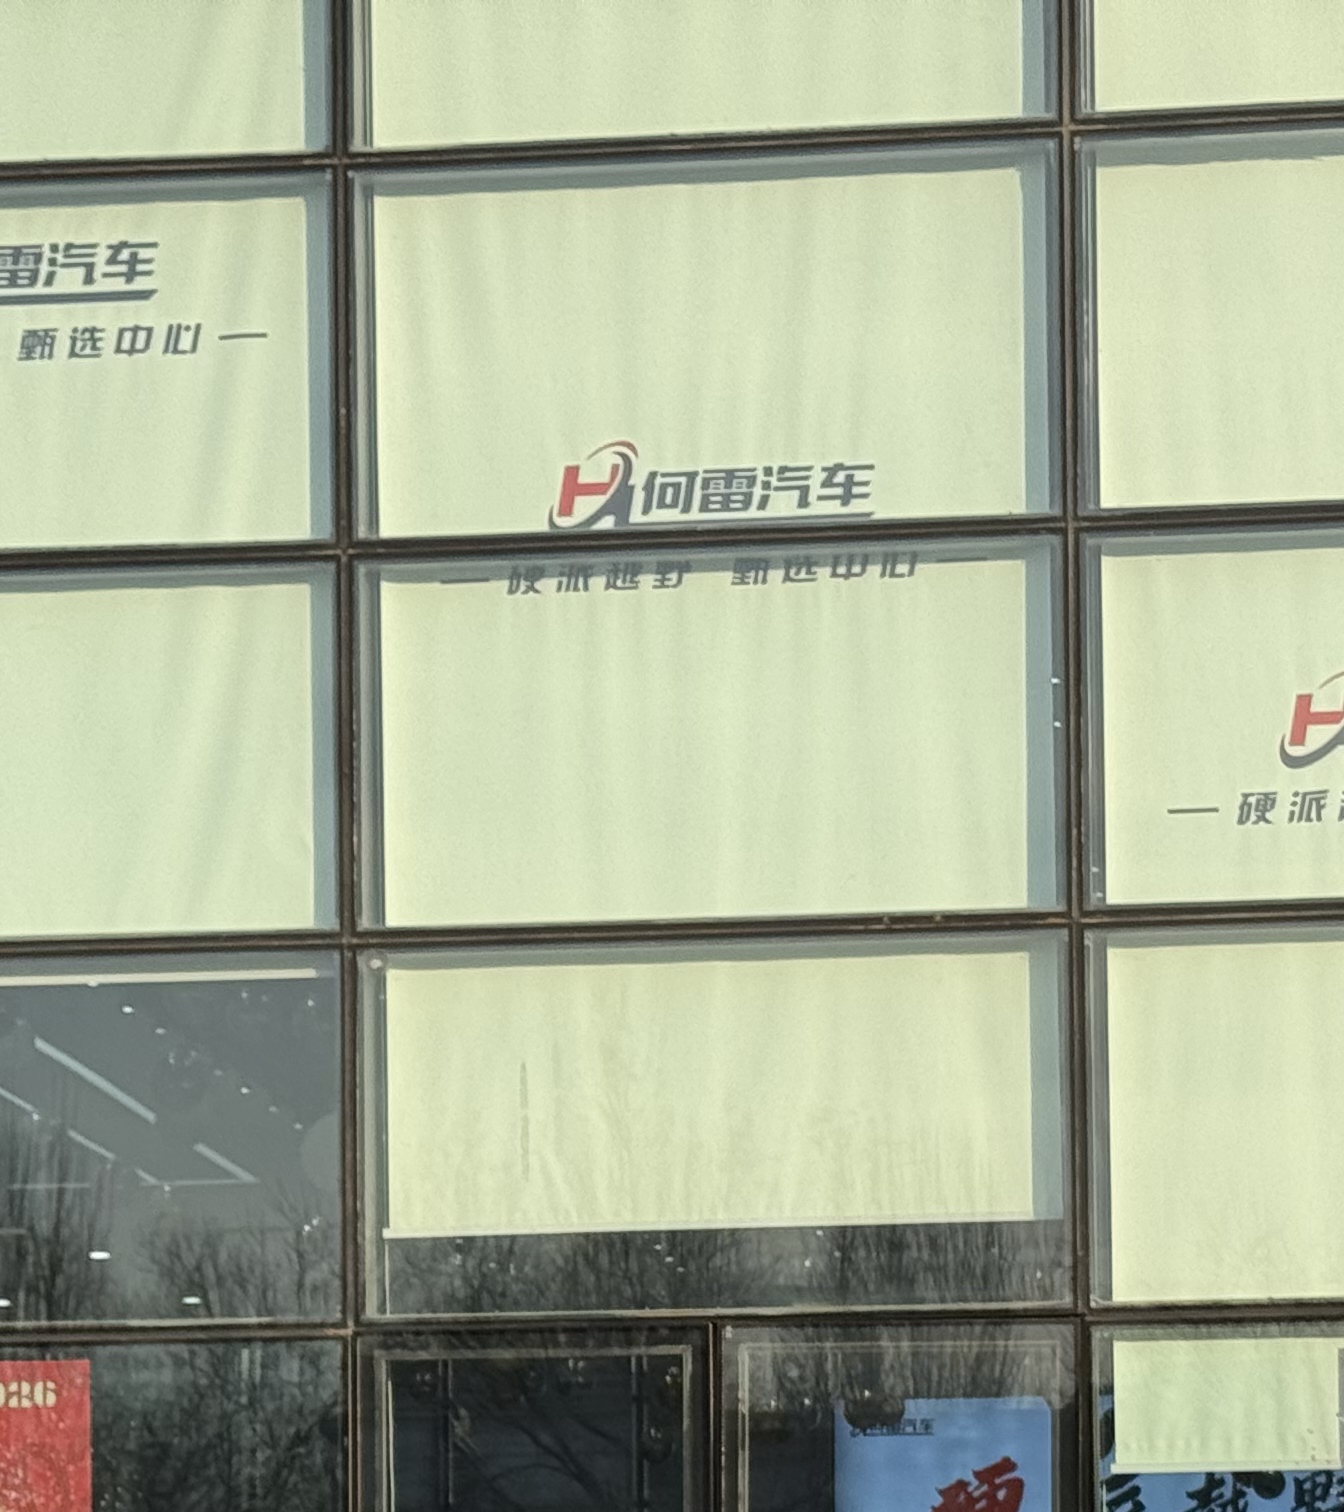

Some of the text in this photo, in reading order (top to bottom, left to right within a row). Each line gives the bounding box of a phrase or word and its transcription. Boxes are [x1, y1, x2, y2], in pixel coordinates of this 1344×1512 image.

[18, 323, 201, 361] 甄选中心
[641, 463, 875, 515] 何雷汽车
